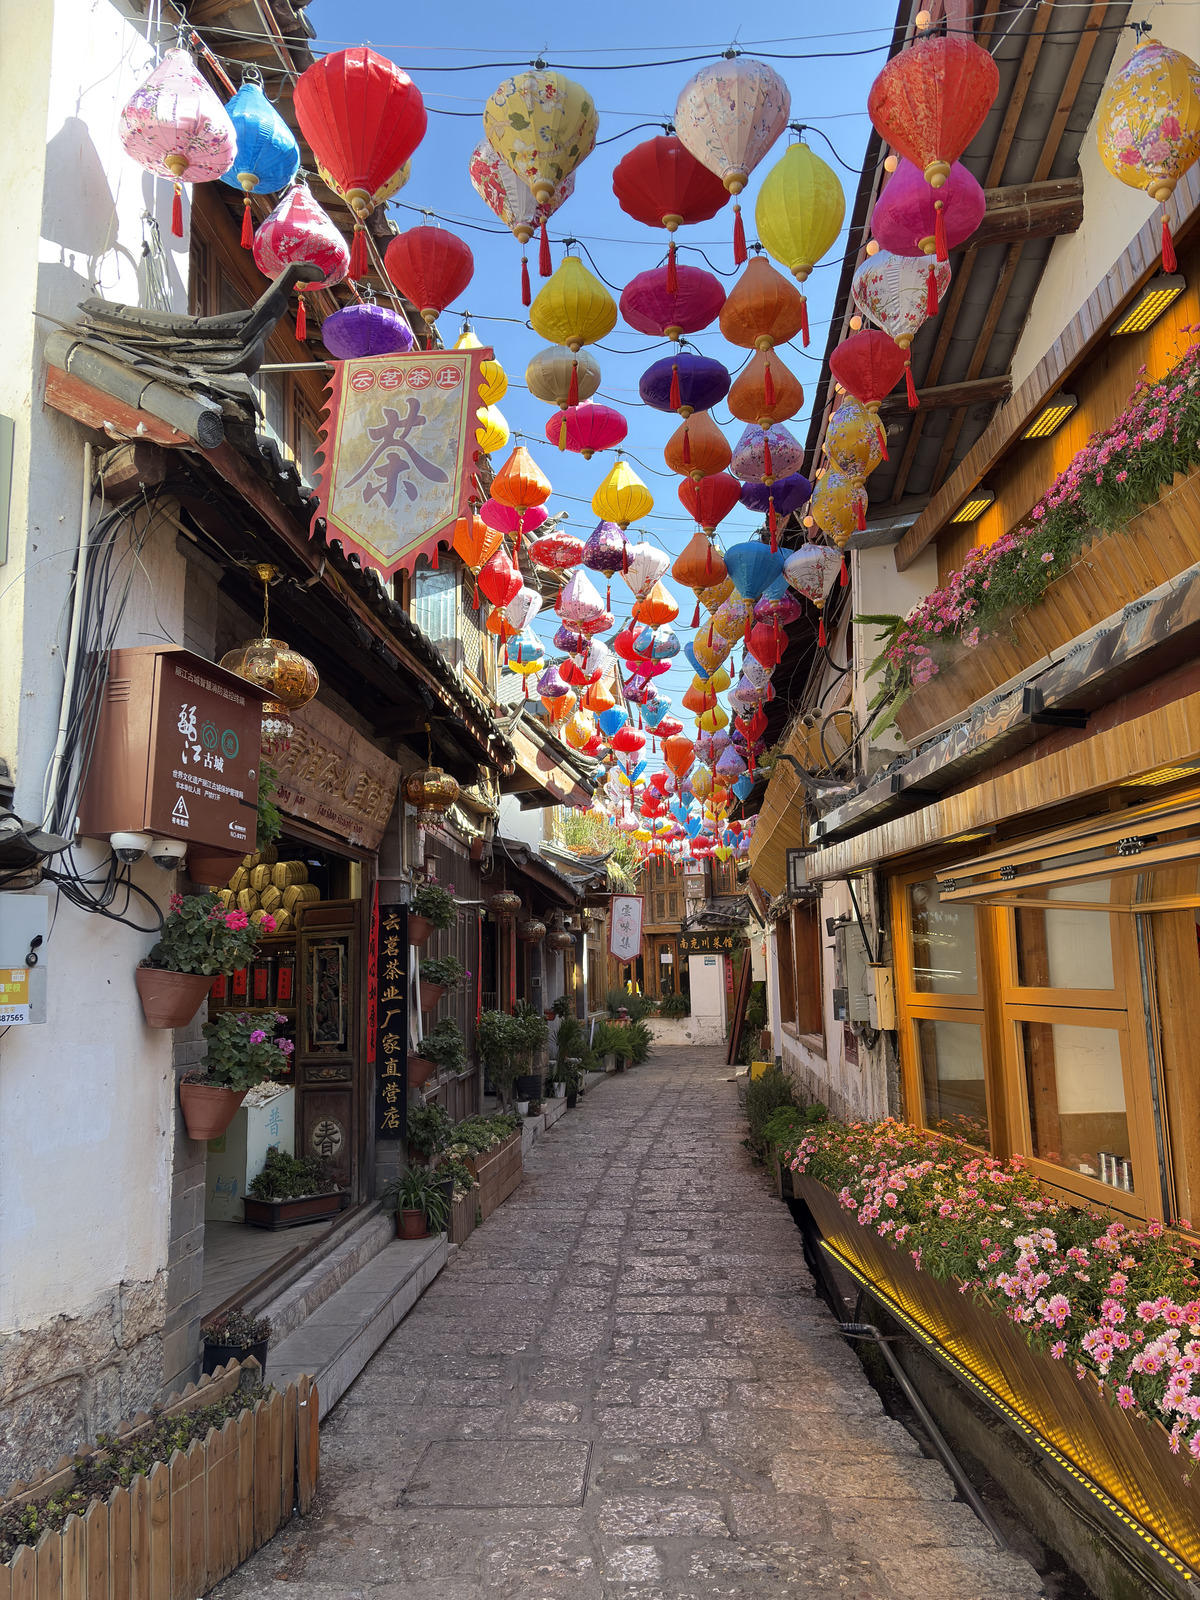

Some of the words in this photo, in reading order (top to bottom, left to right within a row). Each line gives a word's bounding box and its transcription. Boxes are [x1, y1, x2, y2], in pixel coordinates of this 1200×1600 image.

[352, 369, 457, 388] 云茗茶庄
[343, 397, 449, 508] 茶
[204, 752, 224, 773] 古城
[679, 935, 733, 949] 南充川菜馆
[381, 913, 405, 1129] 云茗茶业厂家直营店
